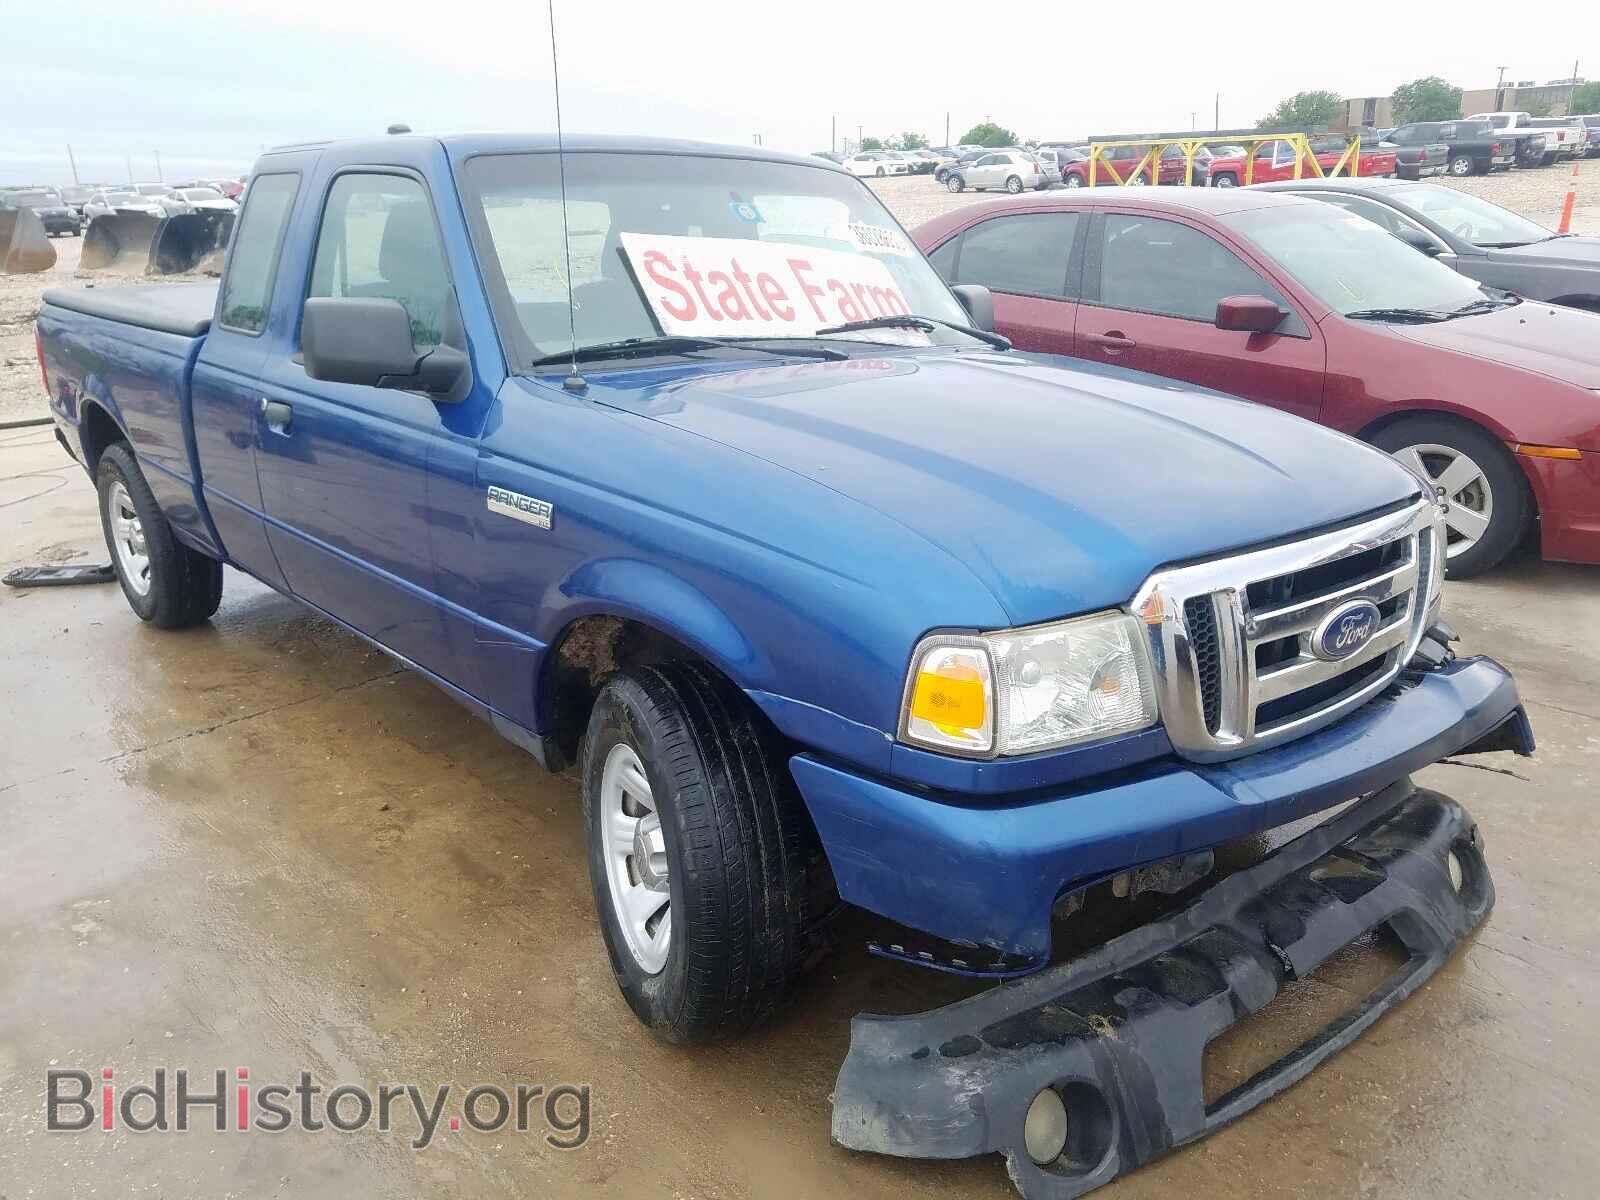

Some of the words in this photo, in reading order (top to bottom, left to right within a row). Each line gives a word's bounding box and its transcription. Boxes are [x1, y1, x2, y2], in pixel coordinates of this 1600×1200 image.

[643, 250, 795, 321] State
[787, 259, 914, 327] Farm
[489, 488, 550, 518] RANGER
[1336, 613, 1371, 648] Ford
